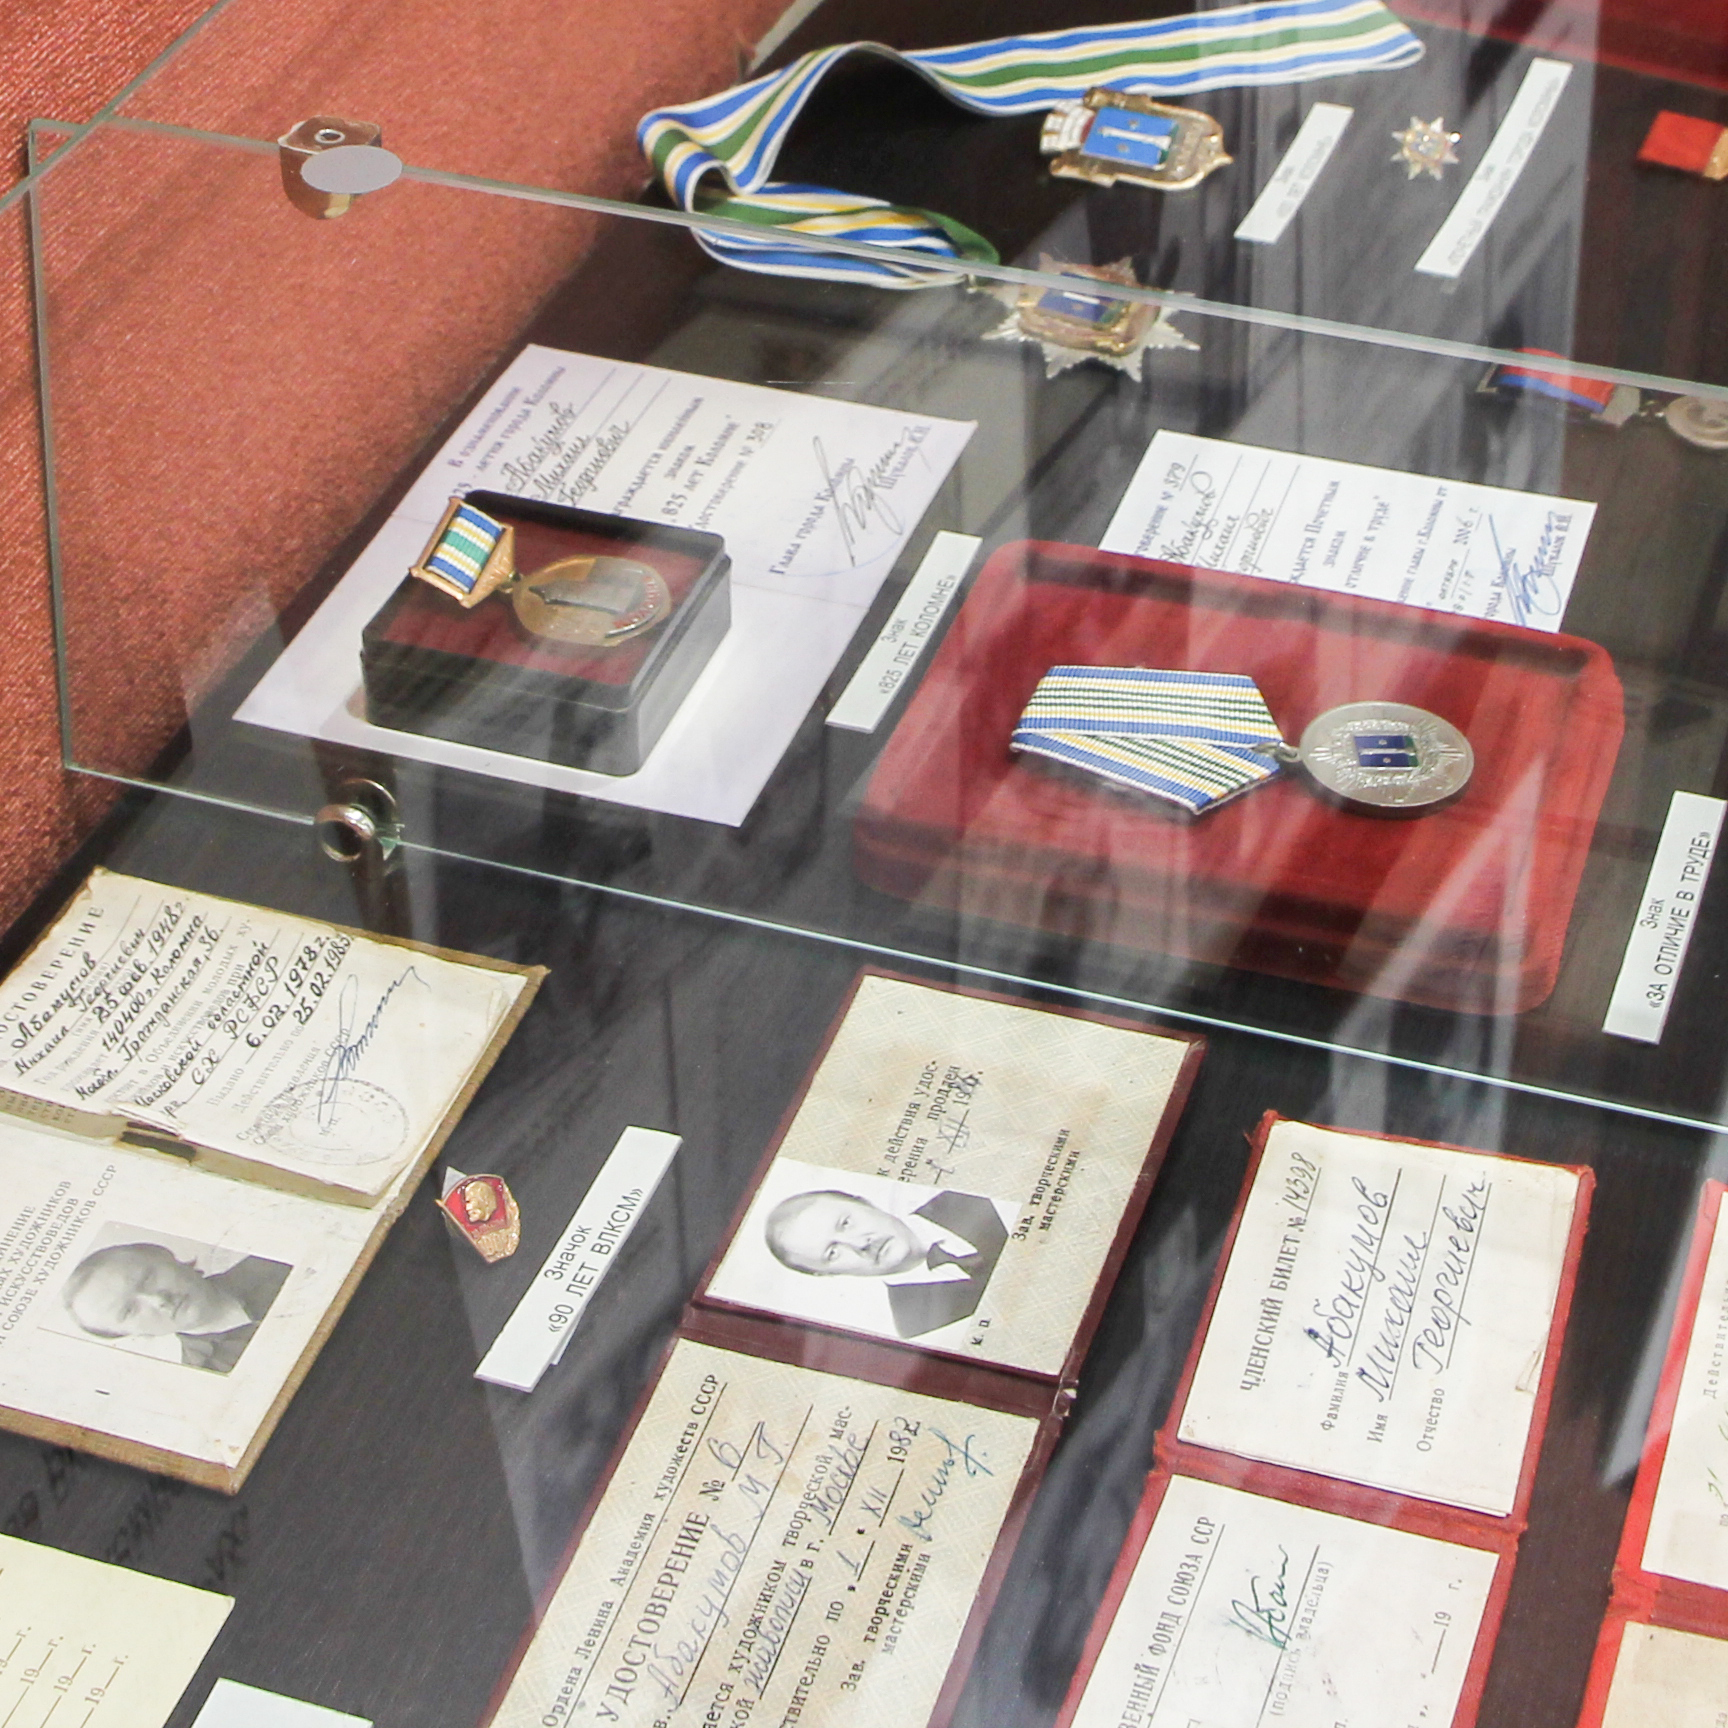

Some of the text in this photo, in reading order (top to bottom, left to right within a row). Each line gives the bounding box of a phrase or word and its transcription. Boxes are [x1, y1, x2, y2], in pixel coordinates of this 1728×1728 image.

[880, 618, 908, 643] Знак
[892, 641, 918, 666] ЛЕТ
[910, 574, 955, 637] КОЛОМНЕ»
[202, 943, 240, 994] молодых
[1639, 898, 1665, 929] Знак
[1645, 831, 1710, 1008] «ЗА ОТЛИЧИЕ В ТРУДЕ»
[884, 1101, 922, 1163] действия
[1011, 1128, 1070, 1241] Зав. творческими
[1038, 1150, 1080, 1231] мастерскими
[1, 1288, 39, 1331] СОЮЗЕ
[33, 1200, 97, 1285] ХУДОЖНИКОВ
[92, 1164, 117, 1196] СССР
[7, 1180, 71, 1264] ХУДОЖНИКОВ
[543, 1225, 592, 1280] Значок
[548, 1188, 642, 1333] «90 ЛЕТ ВЛКСМ»
[1240, 1151, 1318, 1390] ЧЛЕНСКИЙ БИЛЕТ 14398
[1304, 1176, 1398, 1431] Фамилия Абакумов
[1356, 1231, 1431, 1443] Имя Михаил
[1412, 1182, 1491, 1452] Отчество Георгиевич
[541, 1373, 719, 1728] Ордена Ленина Академия художеств СССР
[597, 1512, 710, 1721] УДОСТОВЕРЕНИЕ
[698, 1479, 726, 1502] №
[728, 1405, 852, 1673] художником творческой мас-
[805, 1538, 825, 1553] г.
[1147, 1516, 1215, 1656] ФОНД СОЮЗА ССР
[644, 1524, 754, 1708] Абакумов
[825, 1600, 845, 1622] по
[840, 1543, 913, 1690] Зав. творческими
[882, 1553, 931, 1652] мастерскими
[1433, 1611, 1452, 1627] 19
